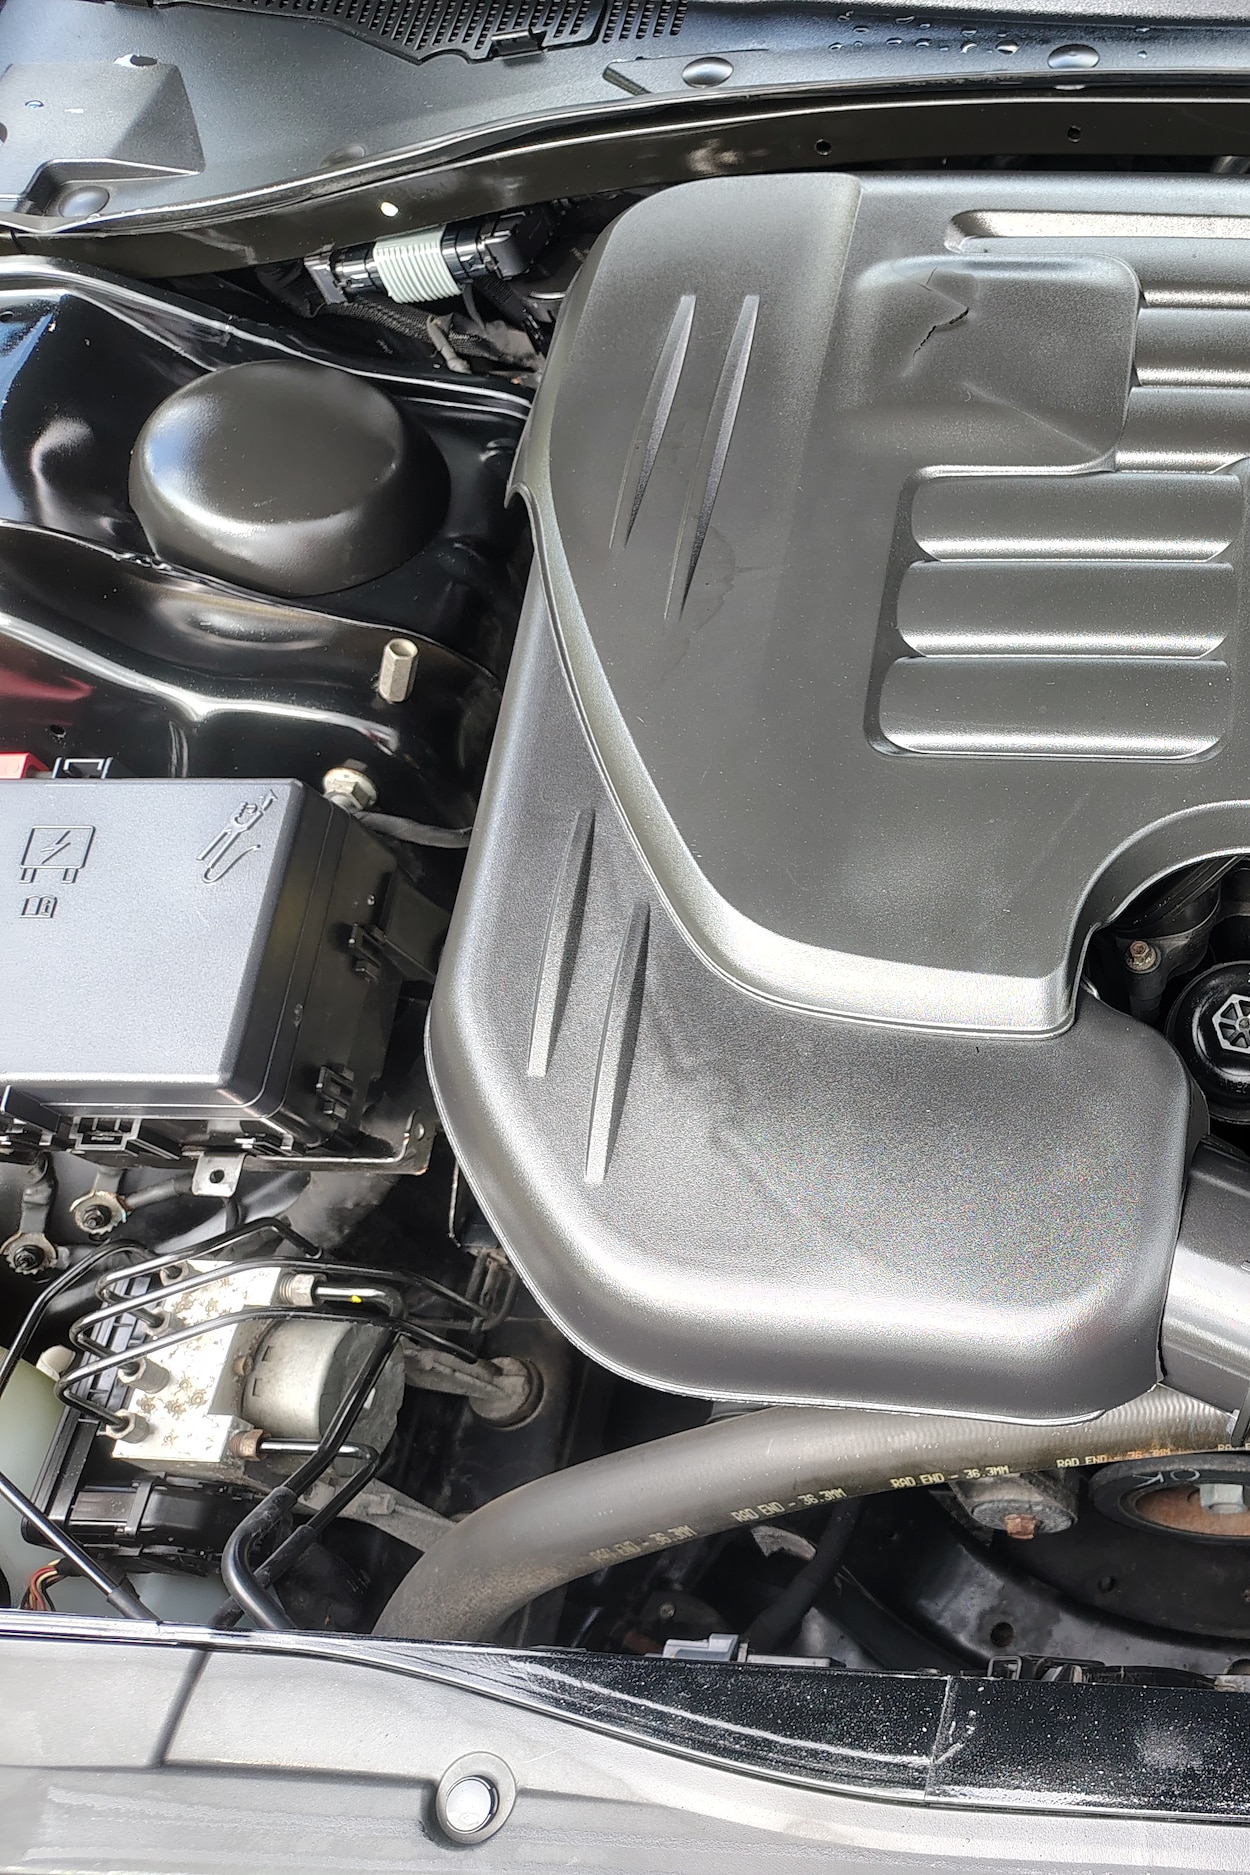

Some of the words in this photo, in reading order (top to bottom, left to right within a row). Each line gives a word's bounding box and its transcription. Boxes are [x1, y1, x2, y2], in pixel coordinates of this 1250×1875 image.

[1056, 1457, 1080, 1468] RAD
[1085, 1454, 1108, 1466] END
[890, 1474, 916, 1489] RAD
[921, 1472, 945, 1486] END
[963, 1464, 1010, 1480] 36.3MM
[730, 1508, 760, 1523] RAD
[757, 1501, 785, 1516] END
[797, 1486, 848, 1510] 36.3MM
[648, 1524, 698, 1546] 36.3MM
